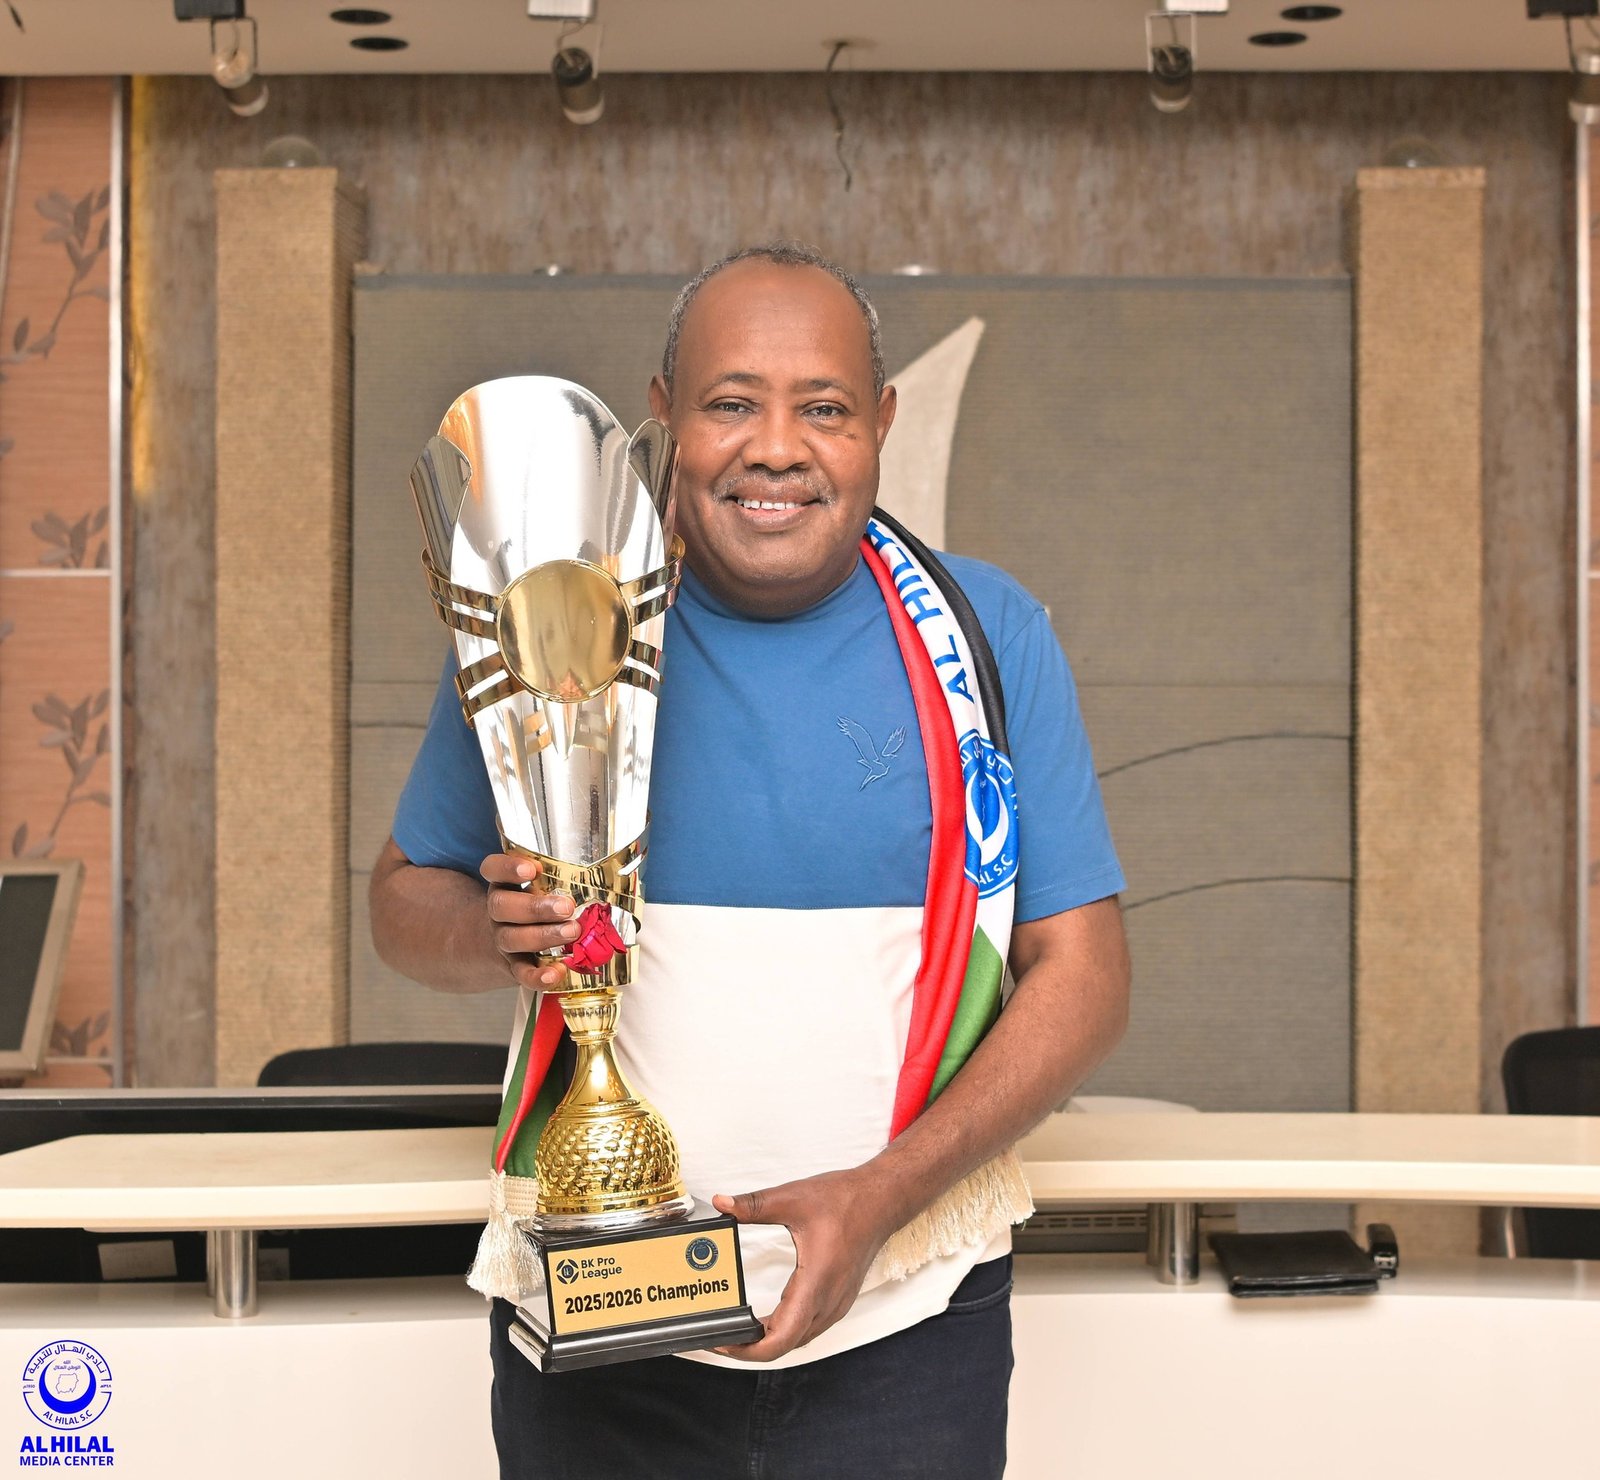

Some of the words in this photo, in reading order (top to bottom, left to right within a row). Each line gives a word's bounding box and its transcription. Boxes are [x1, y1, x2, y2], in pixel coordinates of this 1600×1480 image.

[865, 521, 943, 625] HILA
[934, 634, 975, 704] AL
[993, 854, 1013, 876] S.C
[581, 1259, 595, 1269] BK
[597, 1257, 615, 1267] Pro
[582, 1266, 622, 1279] League
[565, 1288, 642, 1314] 2025/2026
[647, 1279, 729, 1302] Champions
